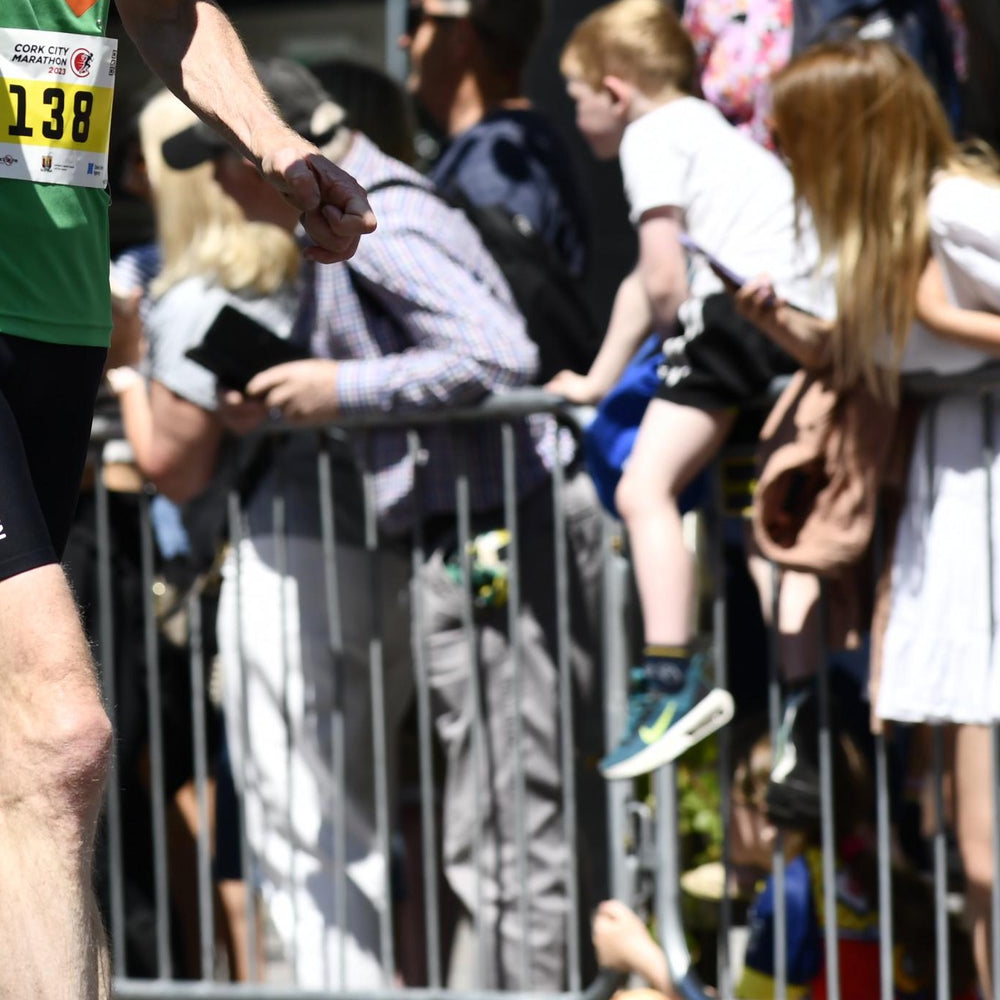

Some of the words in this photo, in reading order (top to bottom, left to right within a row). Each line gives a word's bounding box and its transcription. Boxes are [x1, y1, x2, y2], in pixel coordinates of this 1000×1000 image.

[14, 43, 45, 54] CORK
[48, 46, 69, 56] CITY
[12, 54, 68, 66] MARATHON
[48, 66, 67, 75] 2023
[8, 84, 94, 144] 138
